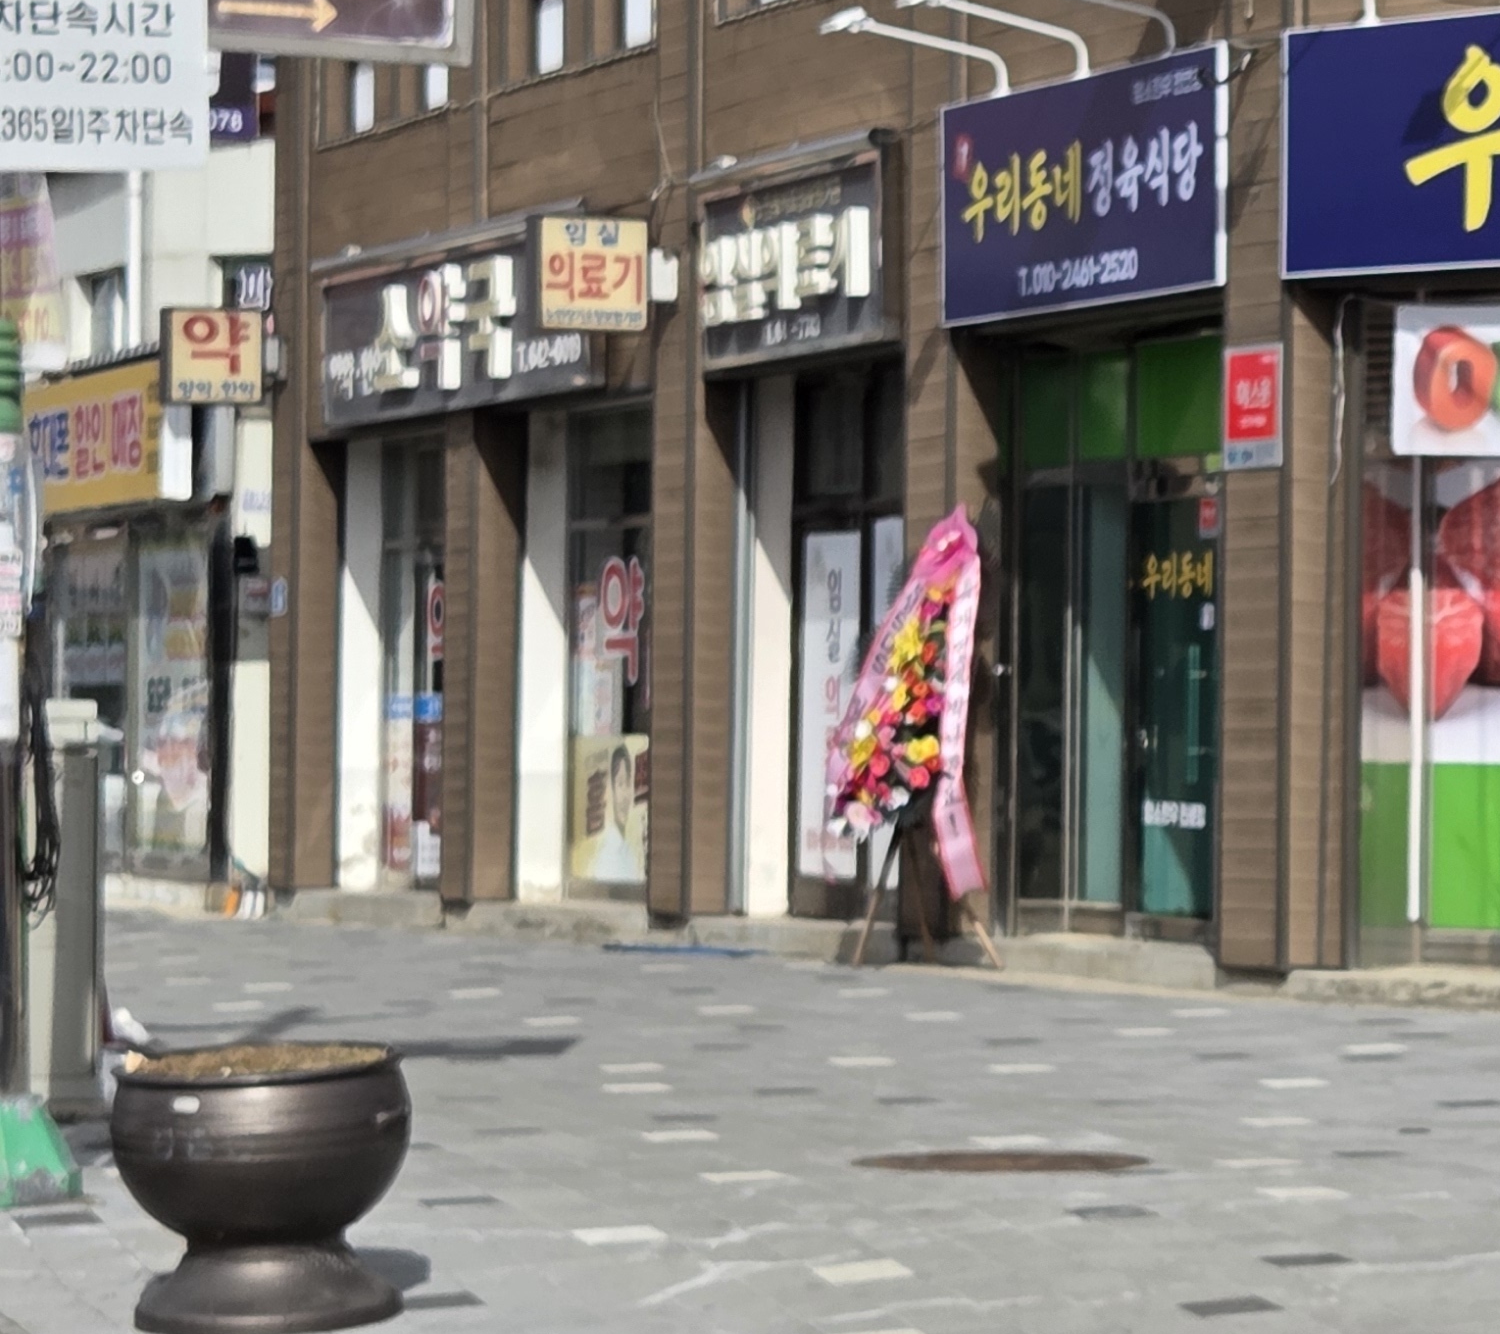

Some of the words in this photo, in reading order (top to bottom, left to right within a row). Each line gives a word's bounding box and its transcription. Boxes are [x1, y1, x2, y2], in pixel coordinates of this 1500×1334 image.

[961, 139, 1082, 245] 우리동네
[1086, 119, 1204, 218] 정육식당
[546, 251, 643, 305] 의료기
[183, 310, 251, 376] 약
[75, 402, 106, 481] 할인
[111, 394, 144, 470] 매장
[1142, 551, 1214, 599] 우리동네
[602, 555, 645, 686] 약
